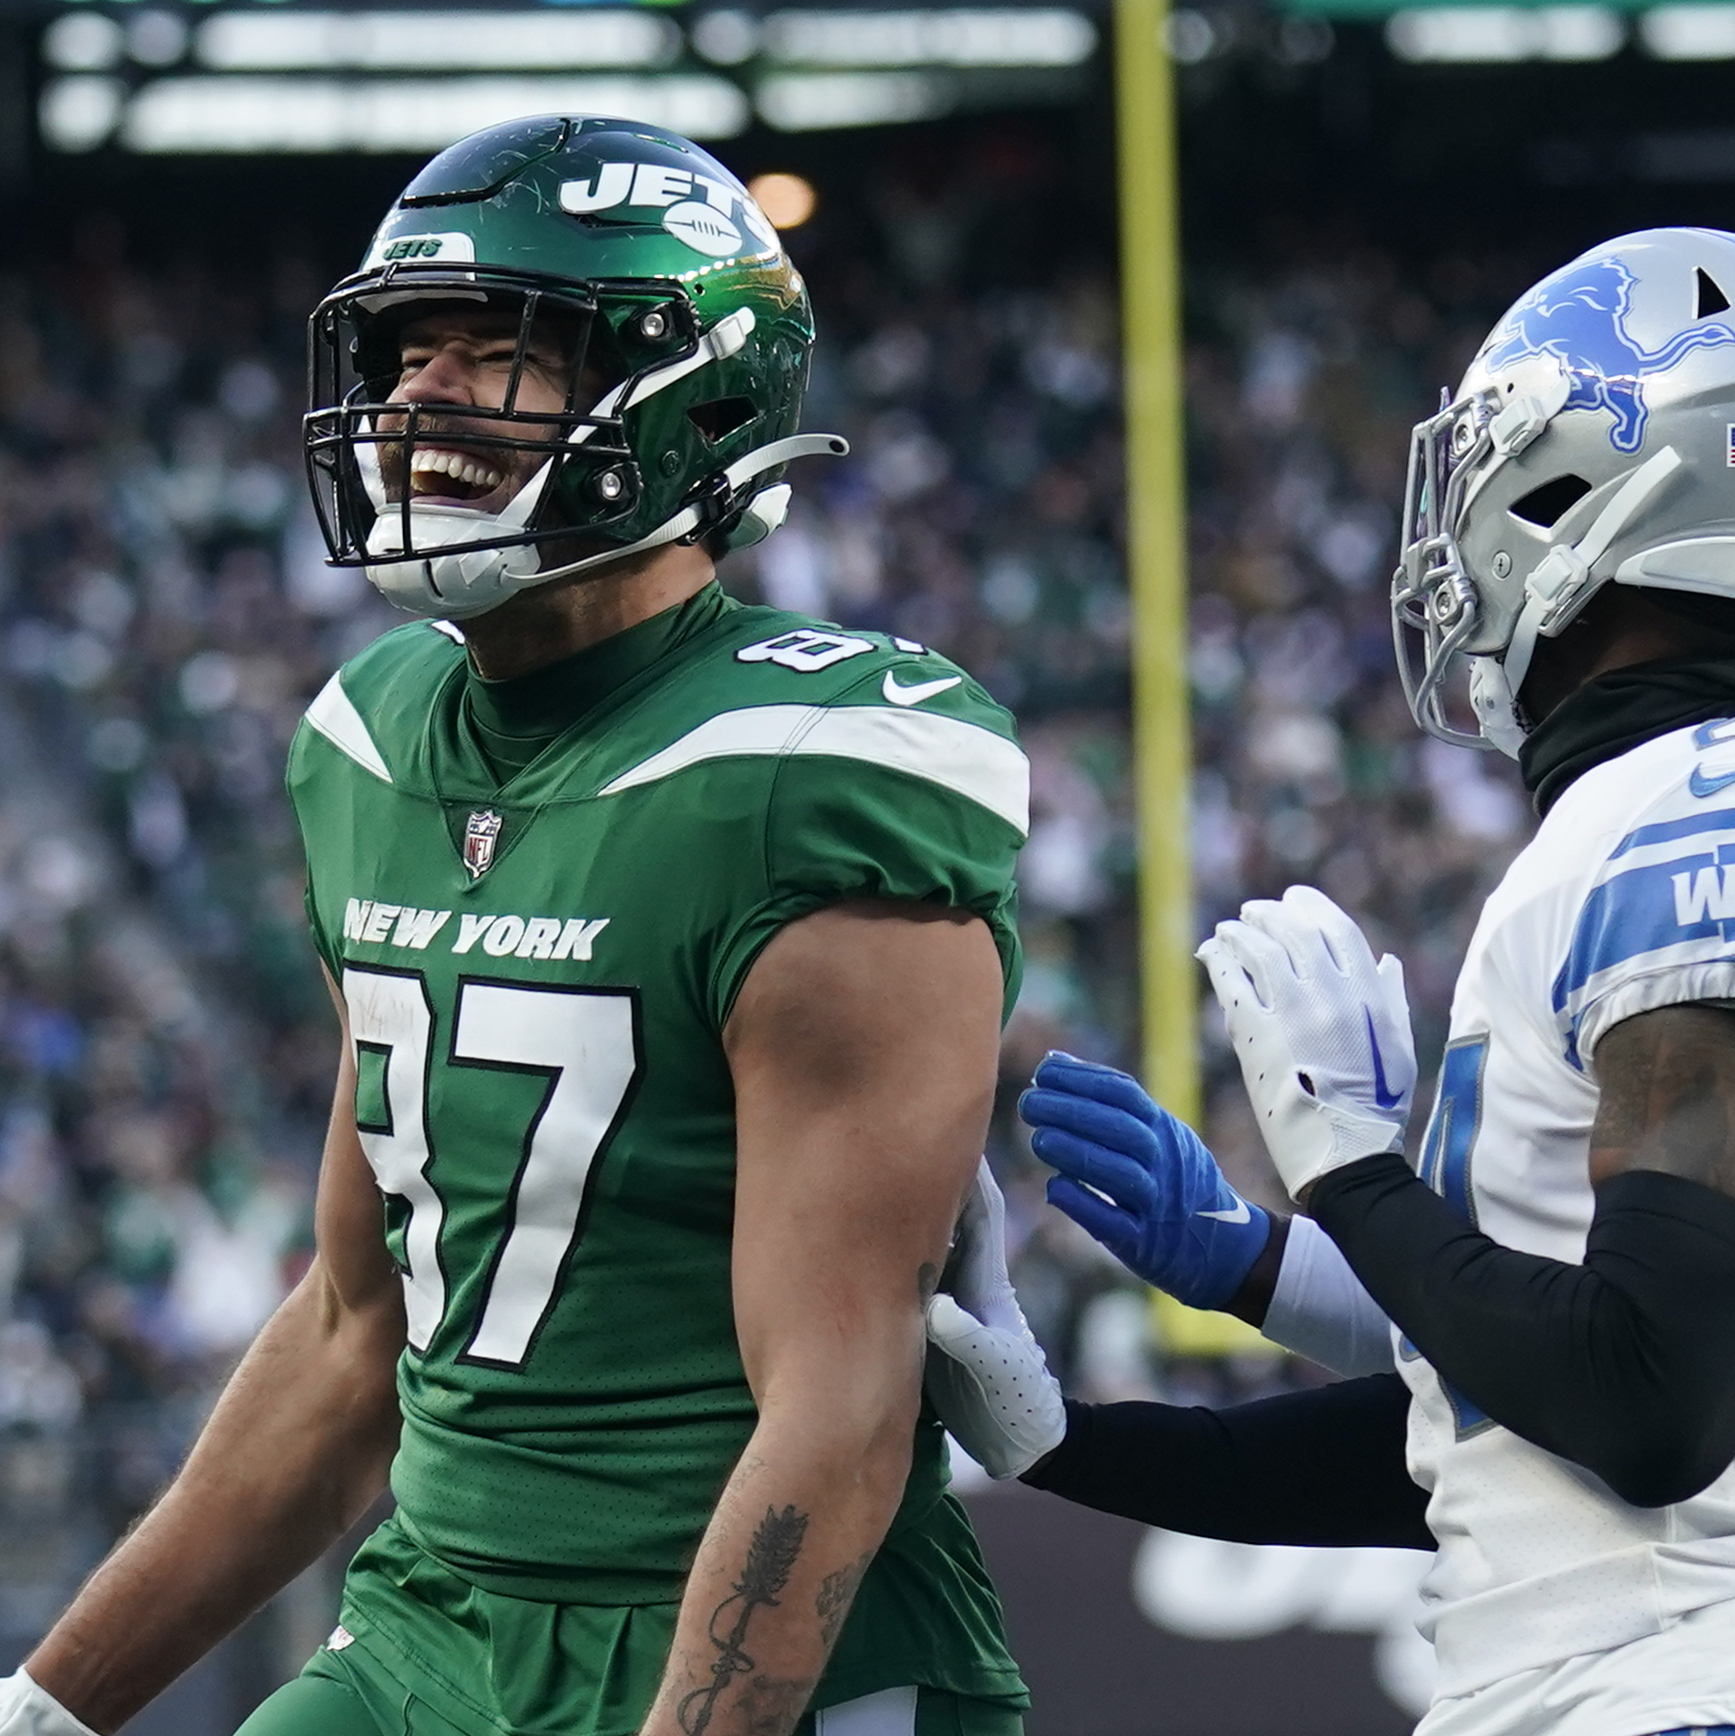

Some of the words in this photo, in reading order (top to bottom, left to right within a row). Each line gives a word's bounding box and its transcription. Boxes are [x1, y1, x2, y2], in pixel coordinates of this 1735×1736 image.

[560, 162, 782, 258] JETS
[383, 239, 443, 261] JETS
[468, 837, 490, 863] NFL
[343, 897, 452, 950] NEW
[452, 914, 611, 961] YORK
